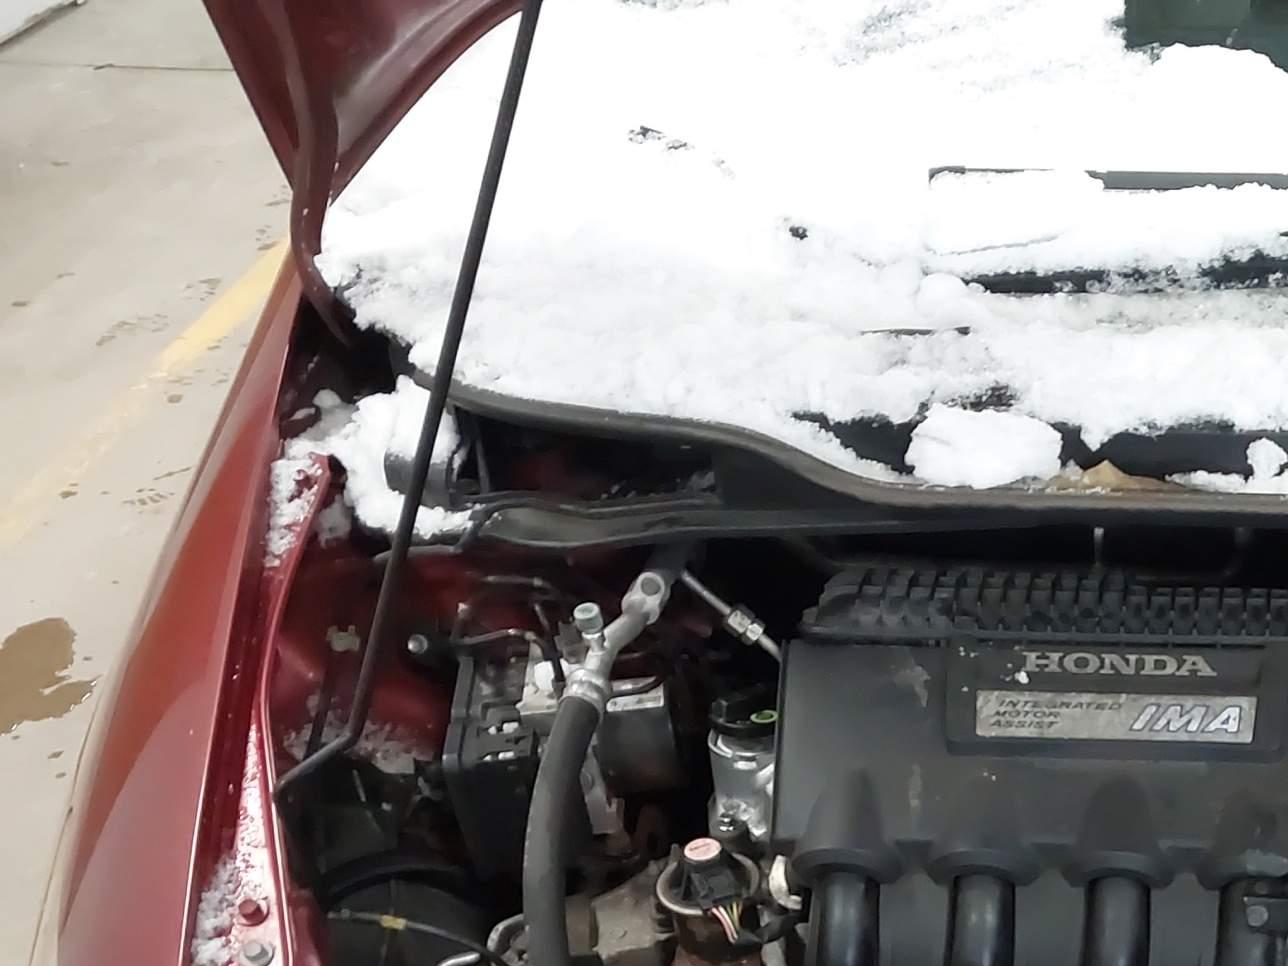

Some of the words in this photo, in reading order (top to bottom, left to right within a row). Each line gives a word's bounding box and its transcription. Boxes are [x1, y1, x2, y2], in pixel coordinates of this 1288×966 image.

[1022, 651, 1218, 677] HONDA
[993, 709, 1062, 720] MOTOR
[1129, 702, 1243, 734] IMA
[990, 719, 1059, 730] ASSIST
